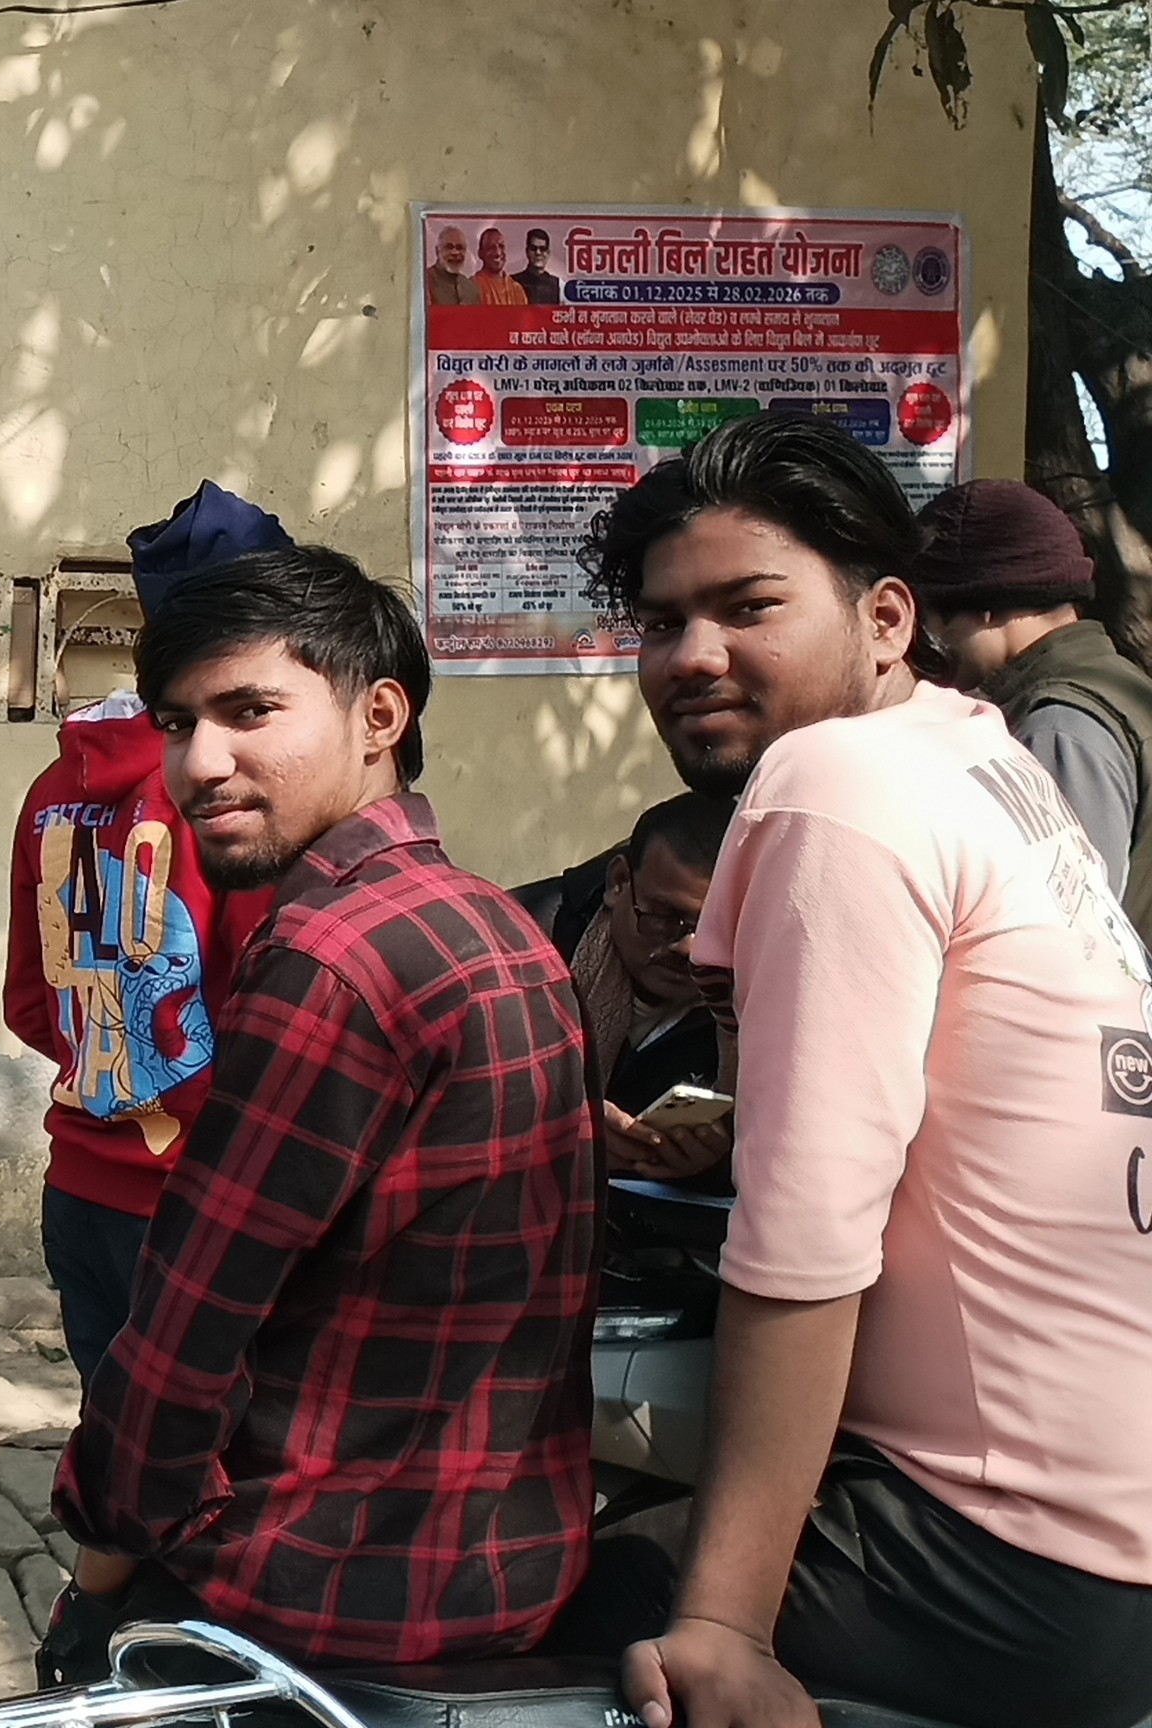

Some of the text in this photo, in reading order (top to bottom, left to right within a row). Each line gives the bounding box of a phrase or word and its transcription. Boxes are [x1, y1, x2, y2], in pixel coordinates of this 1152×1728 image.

[566, 229, 651, 274] बिजली
[656, 229, 709, 274] बिल
[714, 240, 776, 276] राहत
[779, 232, 863, 277] योजना
[576, 281, 829, 302] दिनांक 01.12.2025 से 28.02.2026 तक
[552, 307, 575, 323] कभी
[578, 311, 588, 323] न
[590, 310, 627, 327] भुगतान
[630, 307, 655, 324] करने
[658, 307, 677, 324] वाले
[764, 312, 789, 325] समय
[804, 312, 839, 330] भुगतान
[509, 331, 519, 345] न
[521, 328, 547, 345] करने
[550, 328, 569, 345] वाले
[647, 328, 672, 350] विद्युत
[731, 328, 742, 346] के
[744, 329, 764, 347] लिए
[766, 329, 791, 351] विद्युत
[793, 329, 812, 347] बिल
[437, 354, 473, 375] विद्युत
[478, 354, 509, 372] चोरी
[513, 355, 528, 372] के
[584, 354, 598, 372] में
[601, 355, 627, 372] लगे
[768, 359, 786, 373] पर
[791, 357, 822, 373] 50%
[826, 359, 851, 373] तक
[854, 357, 875, 373] की
[926, 361, 946, 377] छूट
[494, 379, 529, 391] LMV-1
[619, 379, 632, 391] 02
[715, 379, 750, 392] LMV-2
[824, 381, 836, 392] 01
[1115, 1054, 1148, 1073] new
